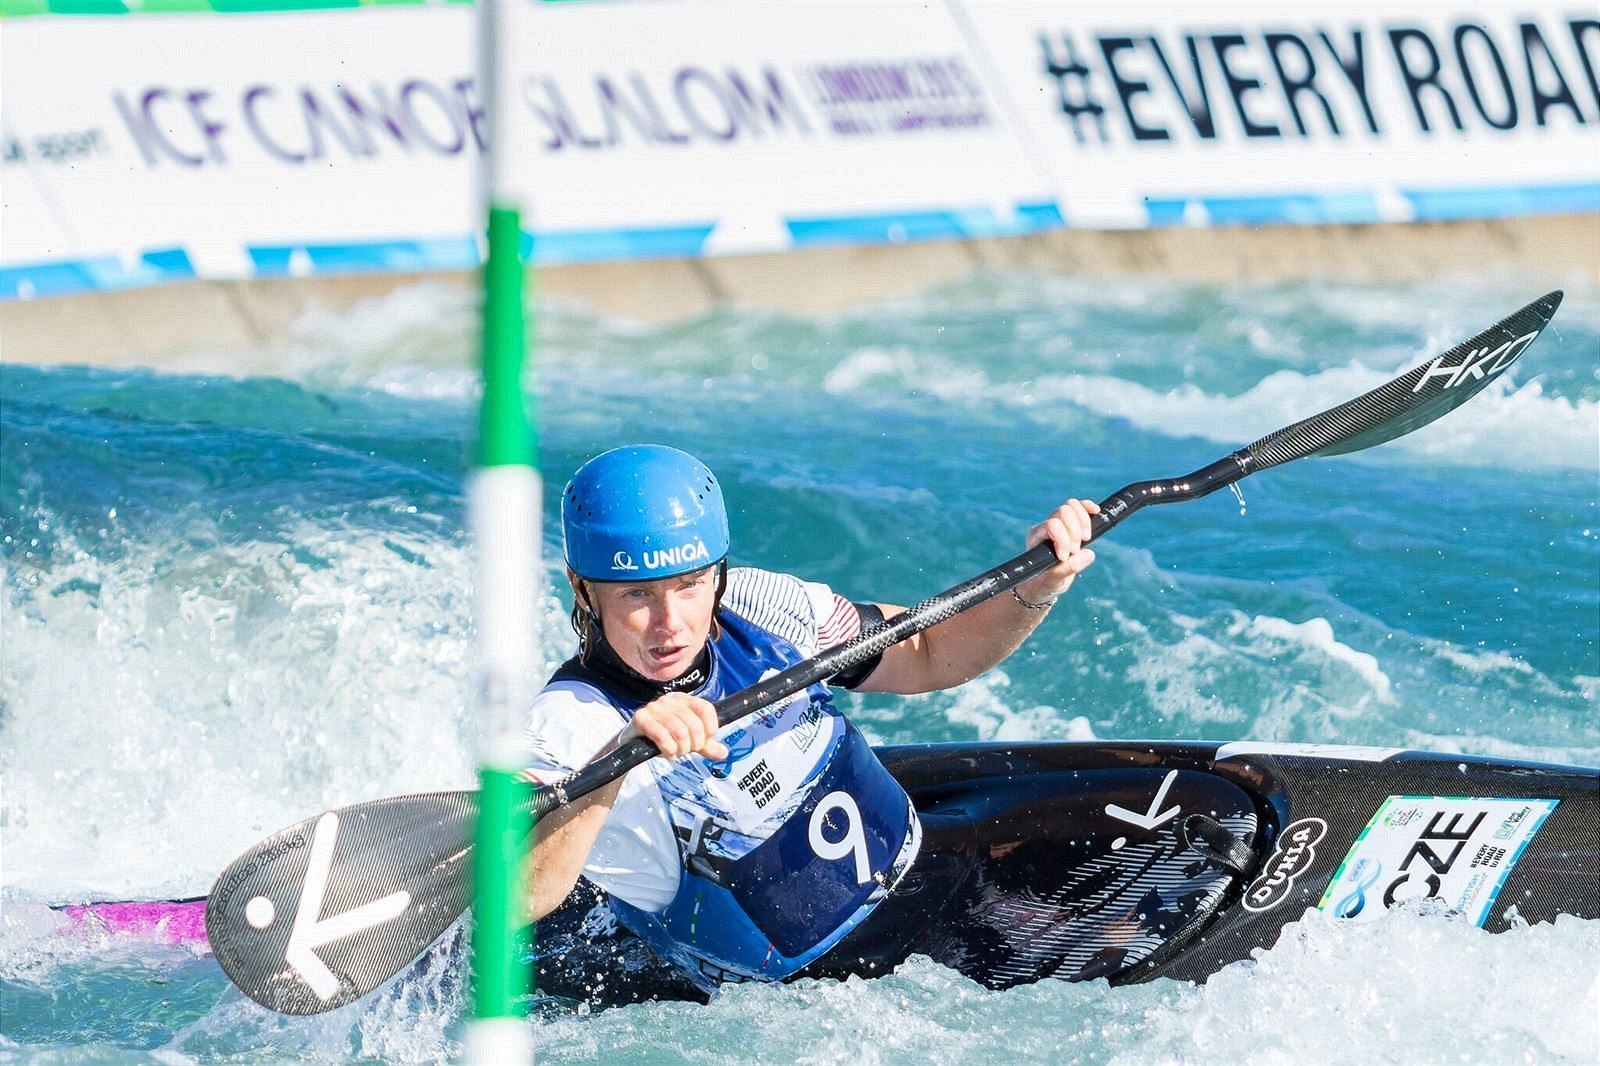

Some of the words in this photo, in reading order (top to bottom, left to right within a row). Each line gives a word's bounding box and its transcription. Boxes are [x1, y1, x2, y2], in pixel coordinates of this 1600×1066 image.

[1038, 30, 1378, 142] #EVERY
[112, 84, 228, 167] ICF
[643, 540, 710, 569] UNIQA
[736, 758, 768, 791] #EVERY
[749, 771, 775, 798] ROAD
[755, 798, 767, 809] to
[764, 782, 781, 802] RIO
[808, 790, 872, 885] 9
[1383, 811, 1489, 910] CZE
[1470, 843, 1490, 868] #EVERY
[1480, 846, 1498, 866] ROAD
[1493, 848, 1507, 861] RIO
